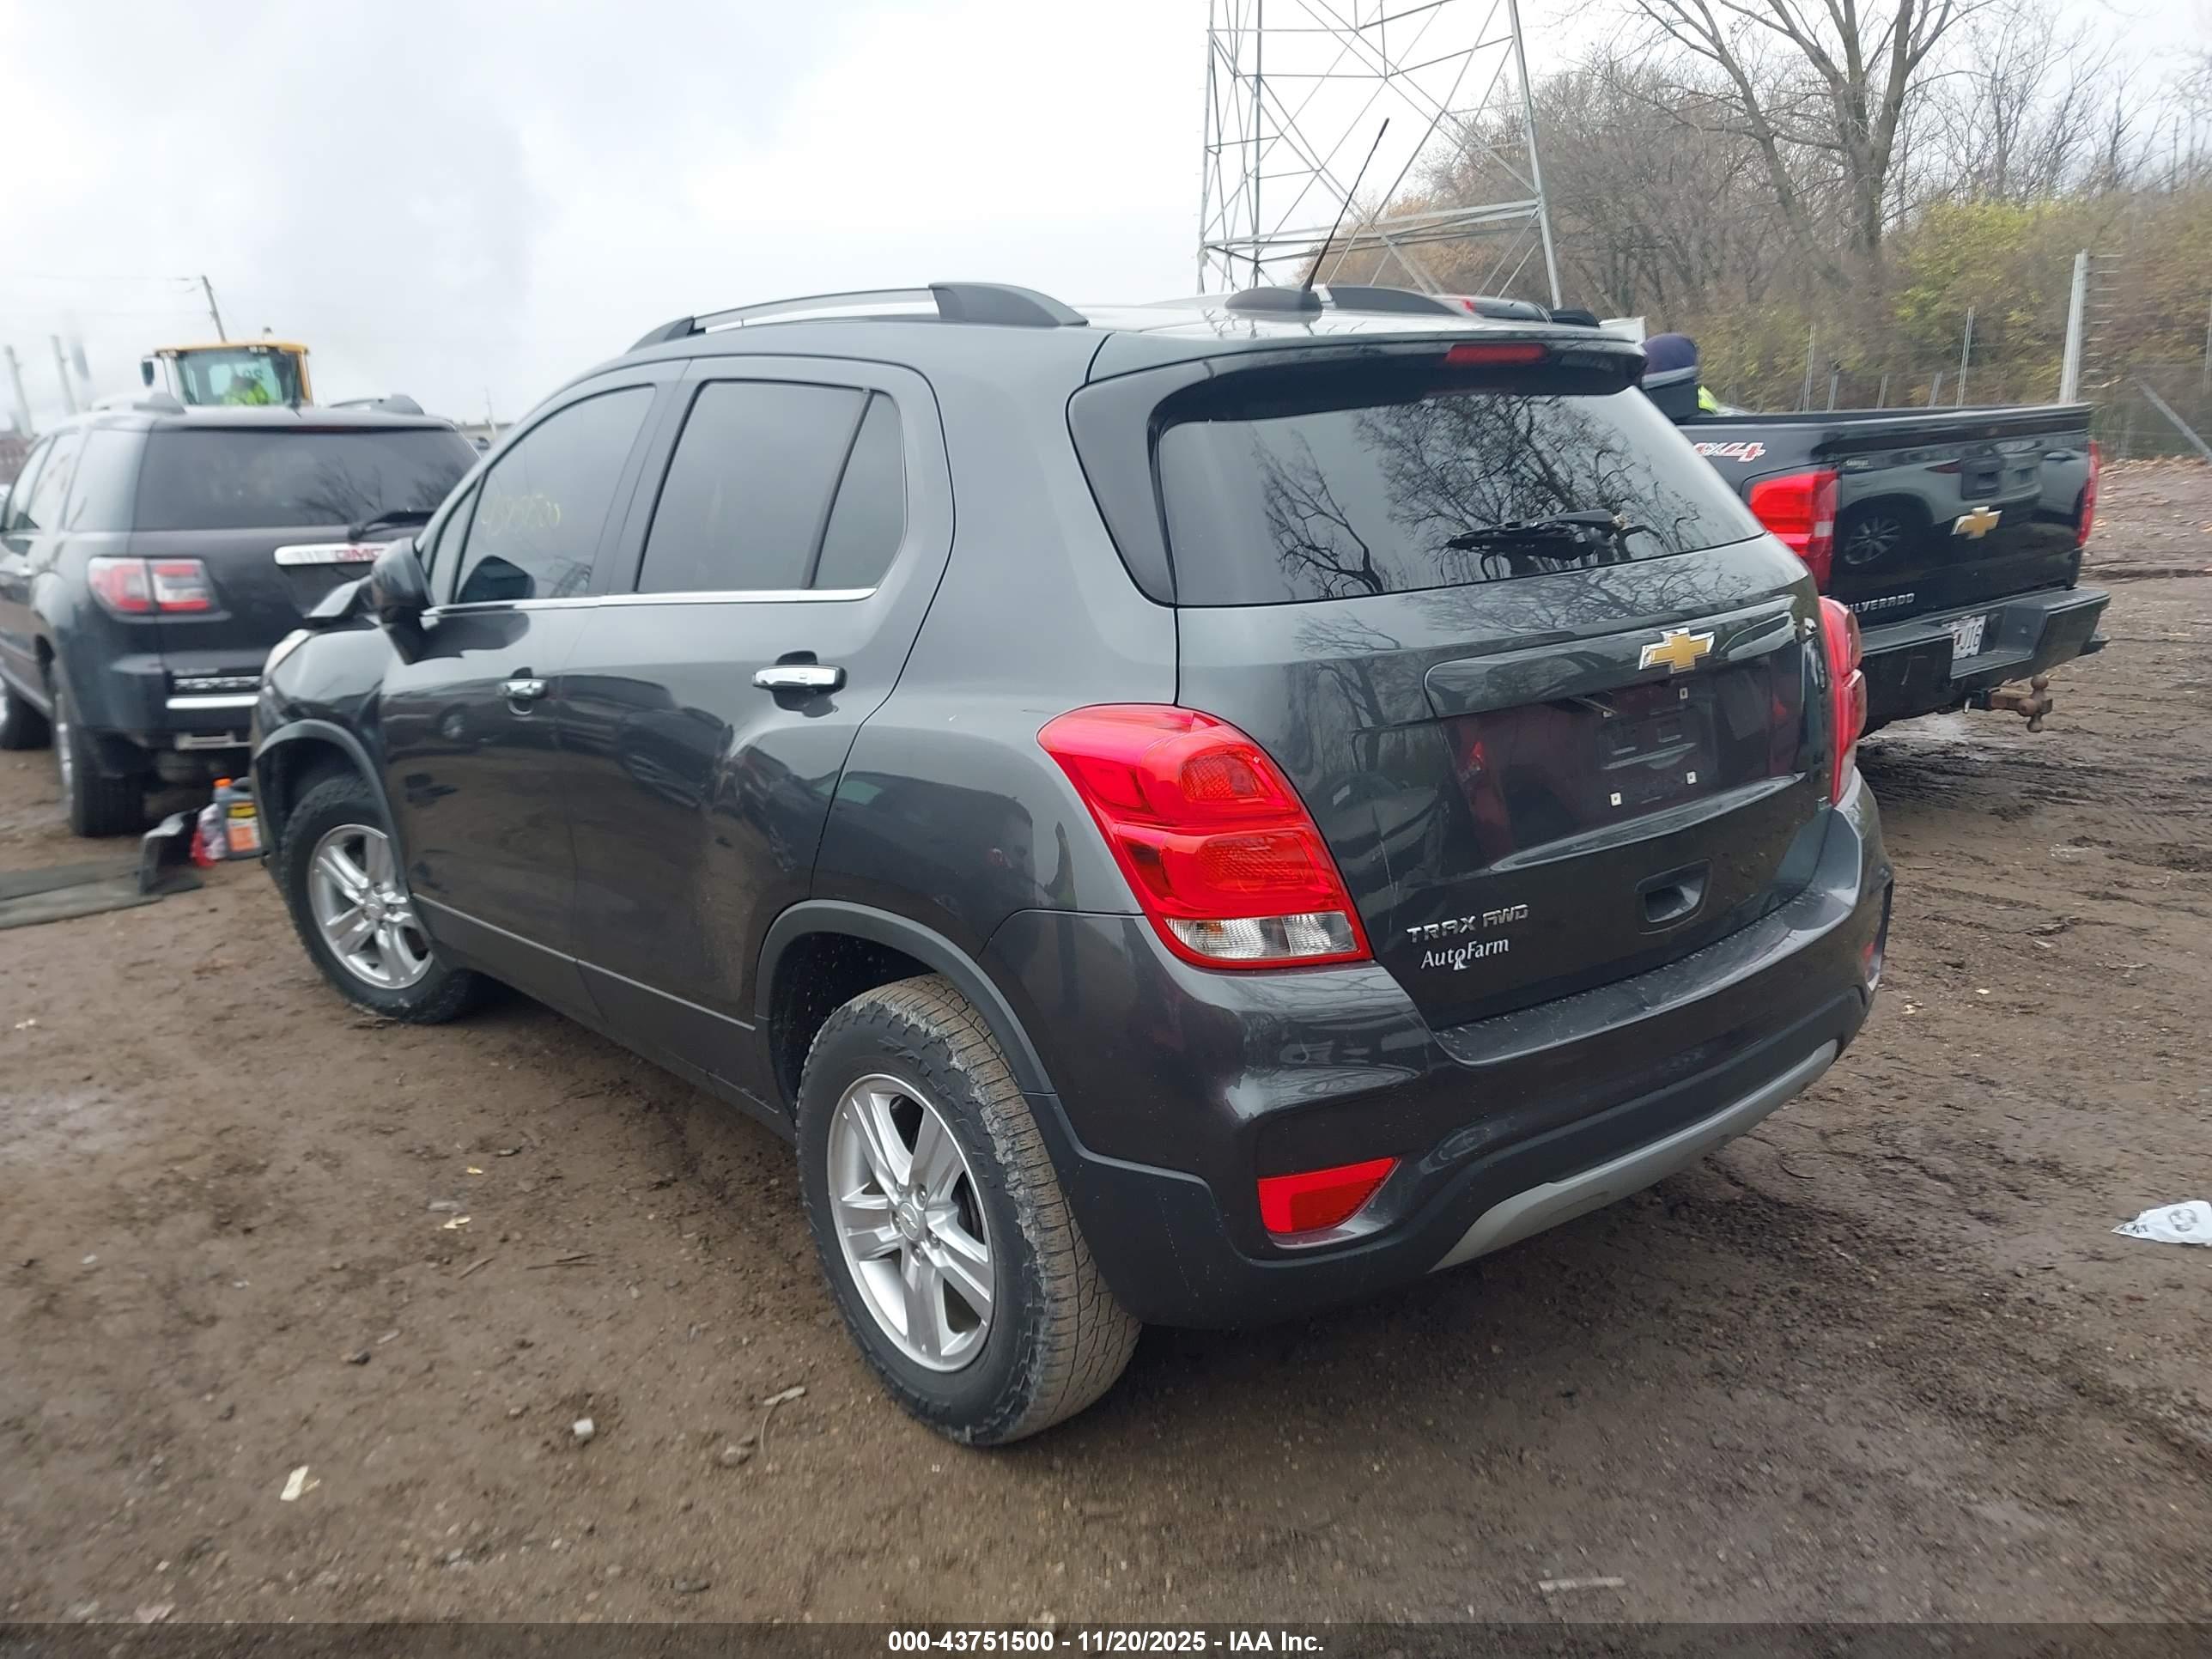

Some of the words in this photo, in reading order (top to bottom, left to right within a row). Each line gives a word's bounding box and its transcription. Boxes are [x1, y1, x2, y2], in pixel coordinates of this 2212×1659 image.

[1844, 592, 1915, 613] ILVERADO
[1407, 915, 1477, 944] TRAX
[1482, 903, 1529, 928] AWD
[1420, 939, 1510, 970] AutoFarm
